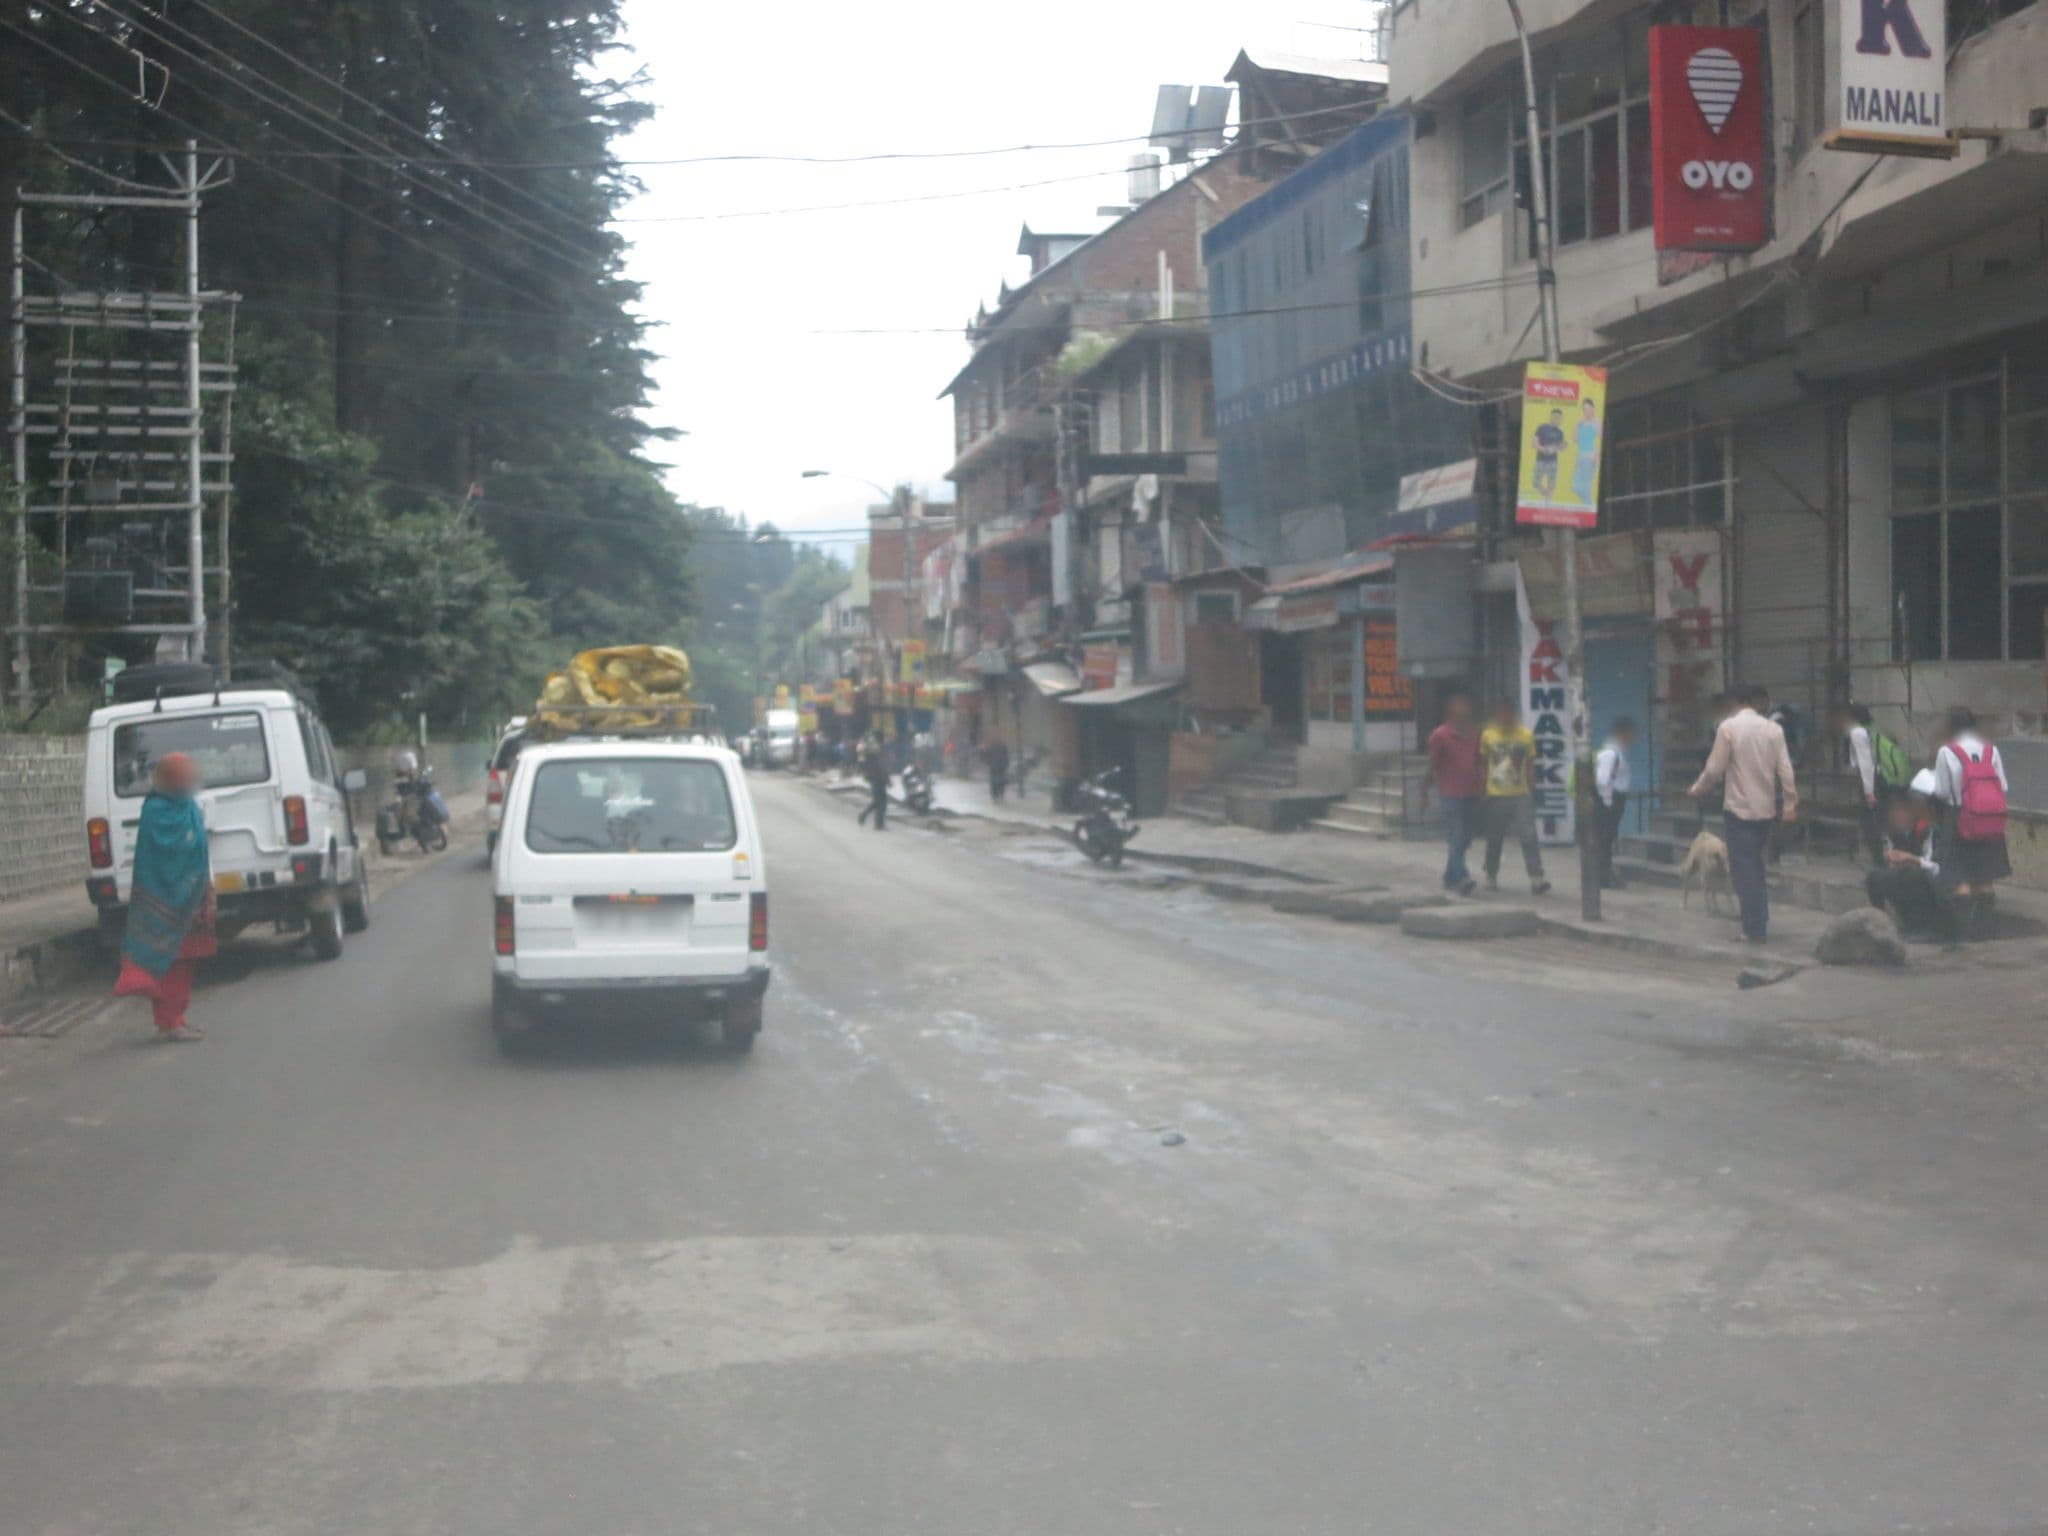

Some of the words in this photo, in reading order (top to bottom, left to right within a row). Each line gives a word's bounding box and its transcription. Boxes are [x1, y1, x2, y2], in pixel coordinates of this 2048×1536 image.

[1846, 86, 1941, 126] MANALI
[1681, 160, 1753, 190] OYO
[1530, 686, 1568, 836] MARKET
